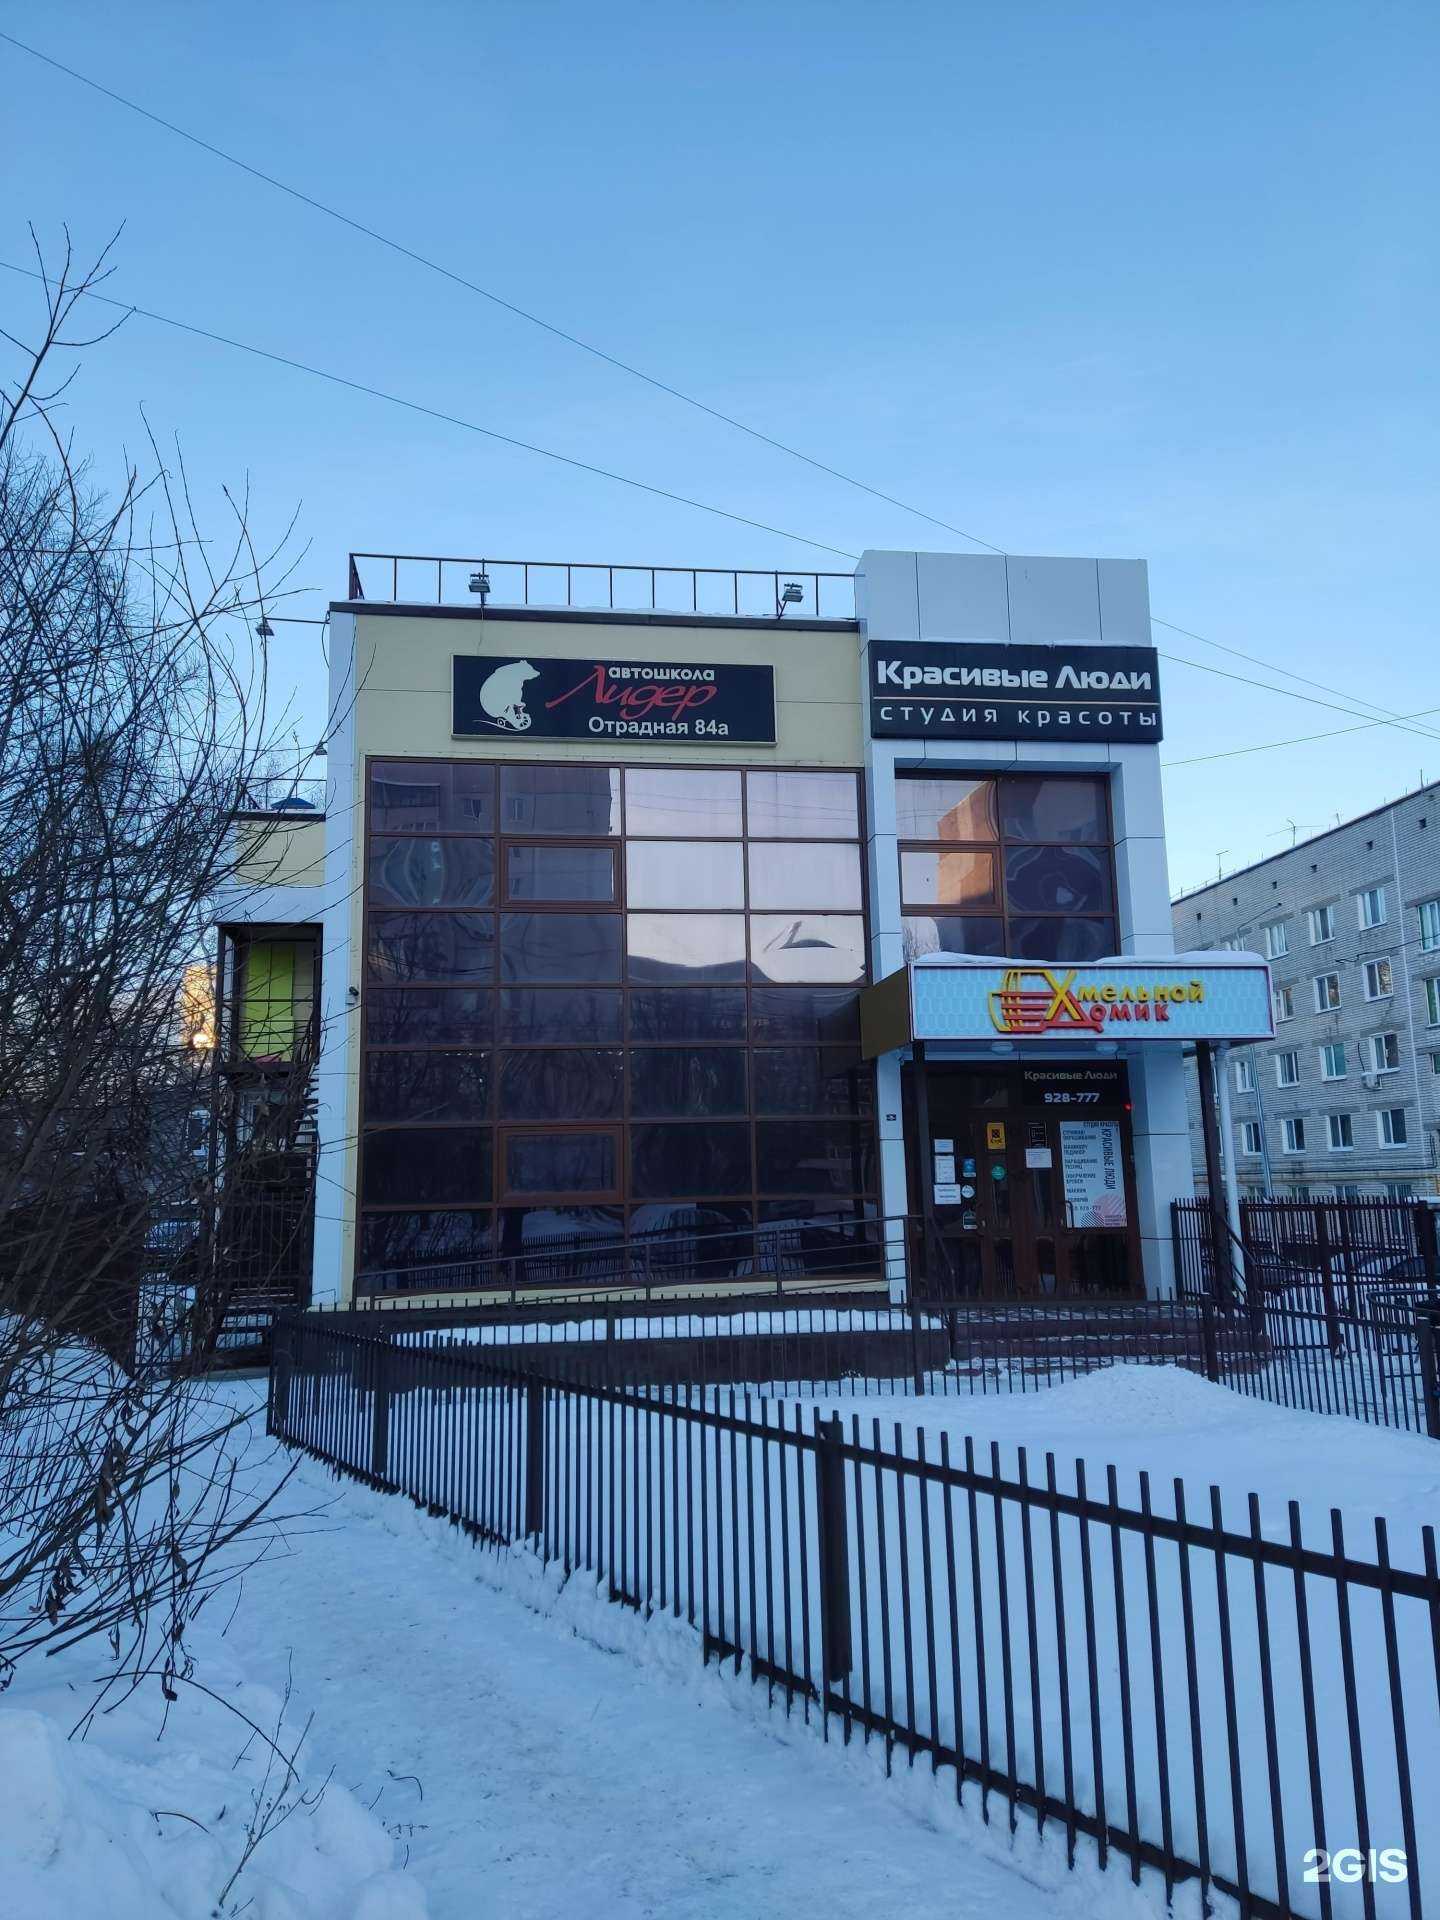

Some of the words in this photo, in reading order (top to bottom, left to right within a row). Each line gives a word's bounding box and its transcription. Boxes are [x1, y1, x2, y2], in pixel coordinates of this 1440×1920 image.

[608, 666, 715, 681] автошкола
[877, 660, 1049, 690] Красивые
[1054, 665, 1152, 690] Люди
[545, 665, 718, 721] Лидер
[588, 716, 689, 736] Отрадная
[695, 719, 729, 736] 84а
[880, 706, 999, 725] студия
[1018, 709, 1158, 728] красоты
[1043, 968, 1205, 1022] Хмельной
[1043, 989, 1170, 1034] Домик
[1024, 1071, 1083, 1082] Красивые
[1084, 1071, 1118, 1080] Люди
[1044, 1092, 1100, 1103] 928-777
